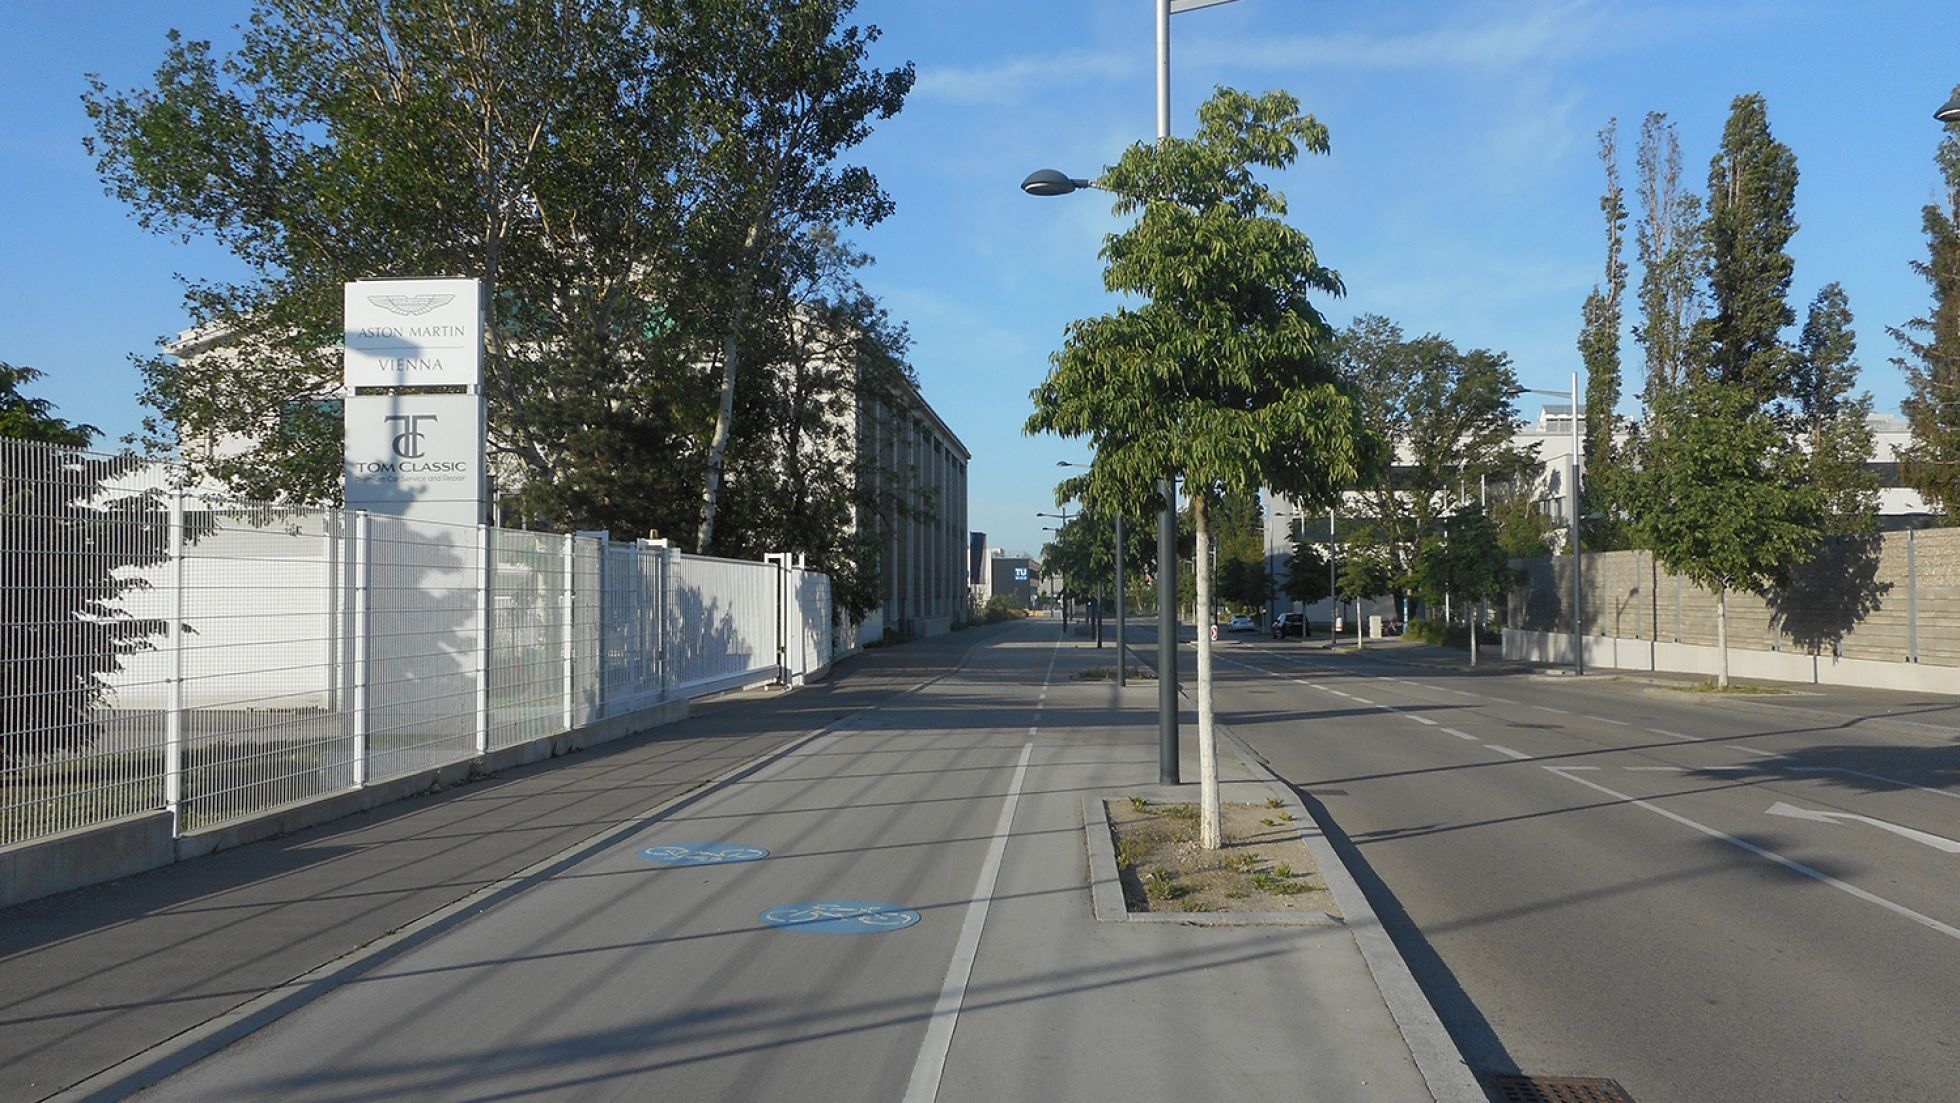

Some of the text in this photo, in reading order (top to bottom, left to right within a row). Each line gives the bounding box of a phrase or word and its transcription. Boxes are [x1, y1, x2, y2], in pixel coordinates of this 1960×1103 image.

[359, 325, 465, 338] ASTON MARTIN
[378, 358, 444, 371] VIENNA
[355, 461, 467, 473] TOM CLASSIC
[1015, 568, 1027, 576] TU
